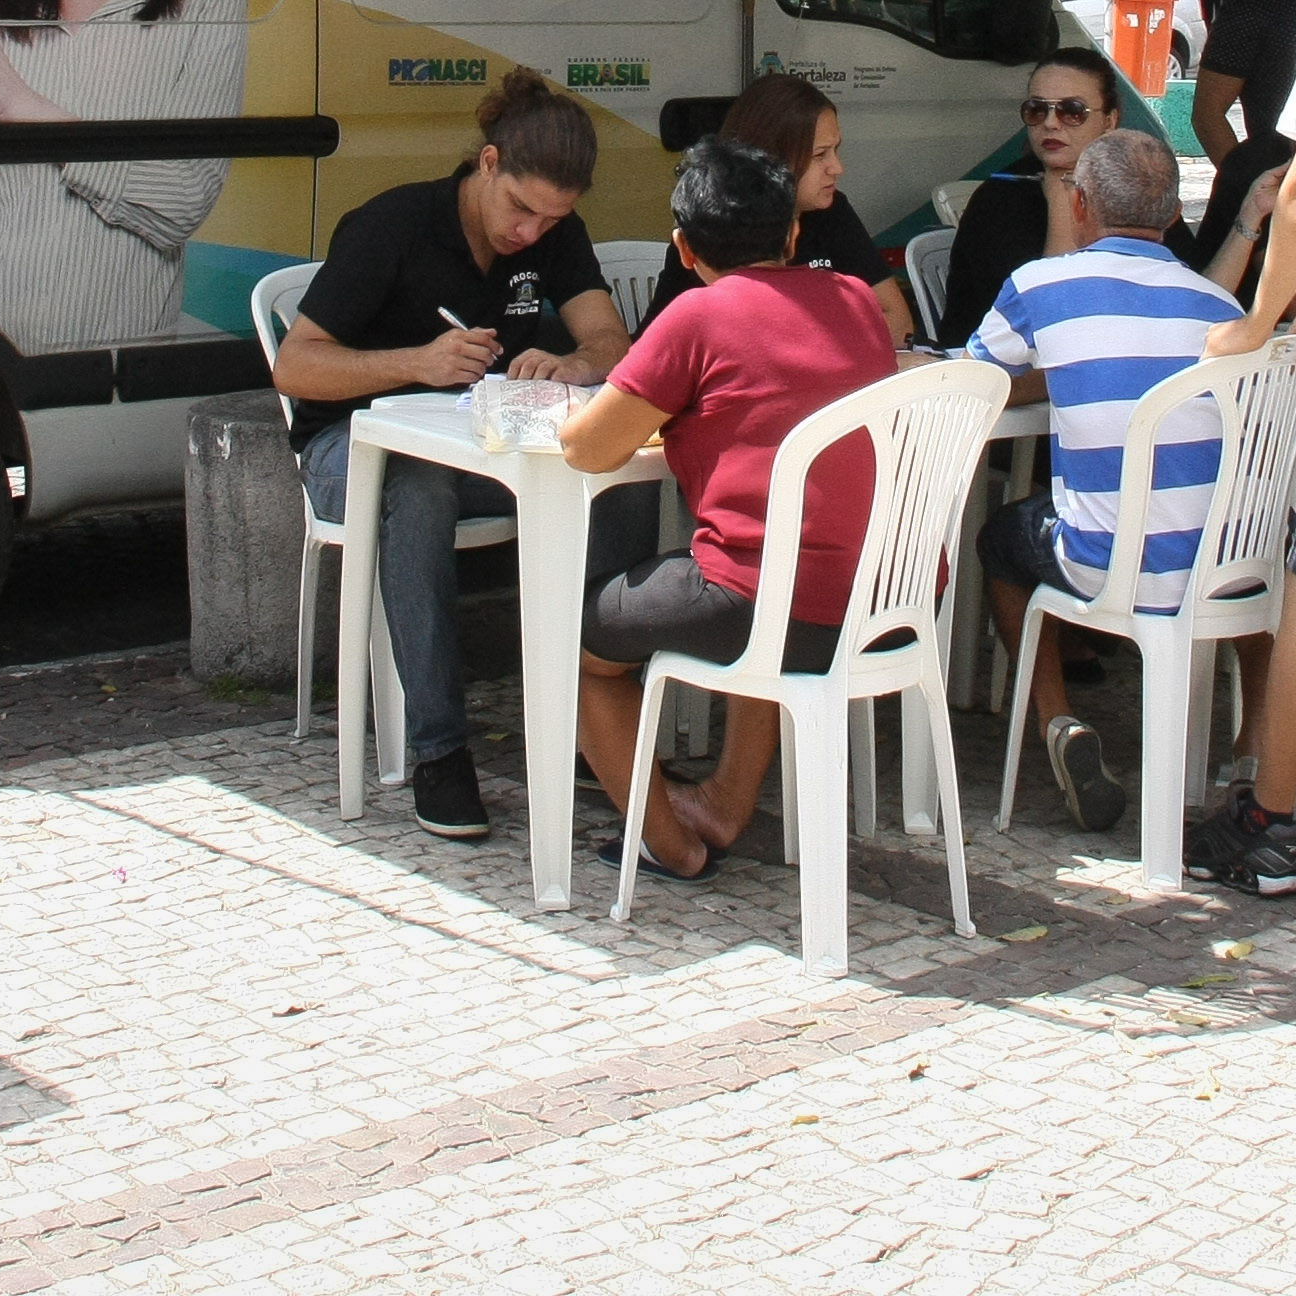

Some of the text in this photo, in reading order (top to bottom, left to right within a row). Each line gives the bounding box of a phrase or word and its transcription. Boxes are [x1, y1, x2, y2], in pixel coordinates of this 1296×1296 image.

[388, 57, 487, 81] PRONASCI
[567, 63, 650, 86] BRASIL
[789, 68, 847, 83] Fortaleza
